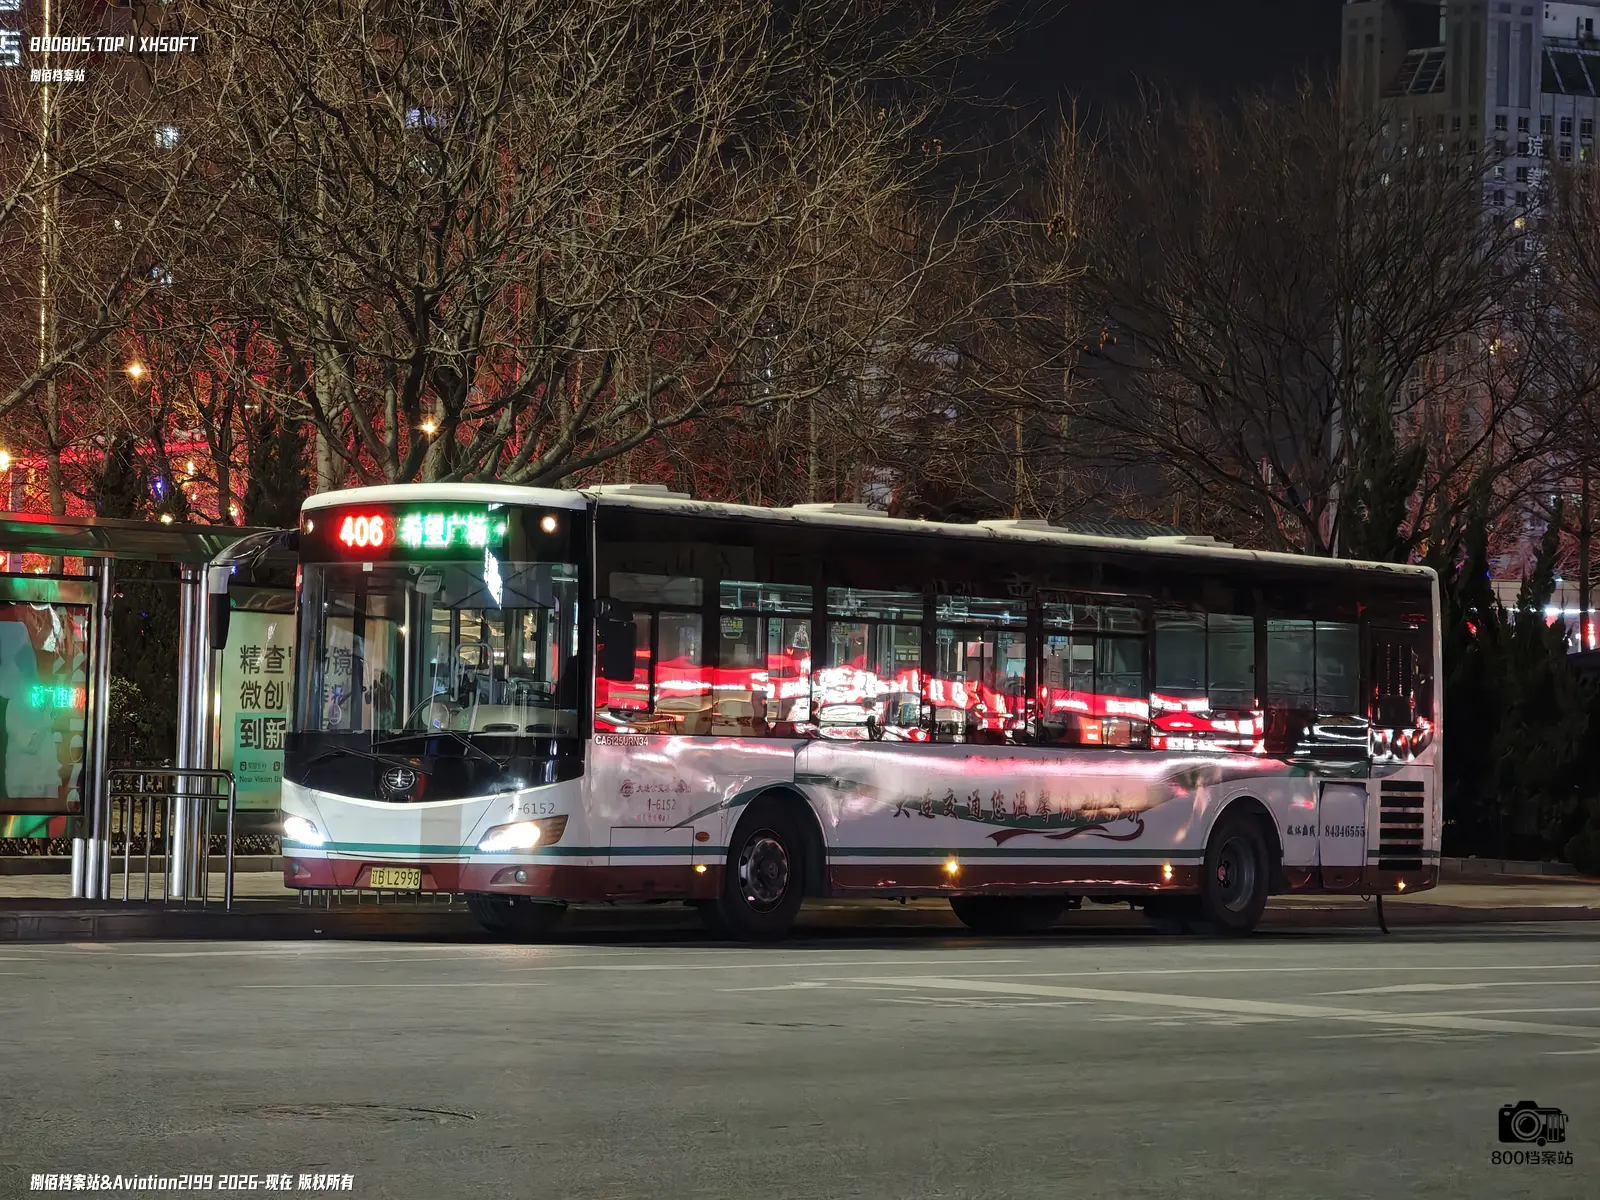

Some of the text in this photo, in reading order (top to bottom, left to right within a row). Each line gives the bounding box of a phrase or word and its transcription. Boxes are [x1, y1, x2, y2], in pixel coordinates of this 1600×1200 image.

[340, 515, 384, 547] 406
[400, 512, 488, 548] 希望广场
[240, 645, 292, 675] 精查
[240, 680, 290, 710] 微创
[507, 802, 555, 815] 1-6152
[647, 799, 677, 812] 1-6152
